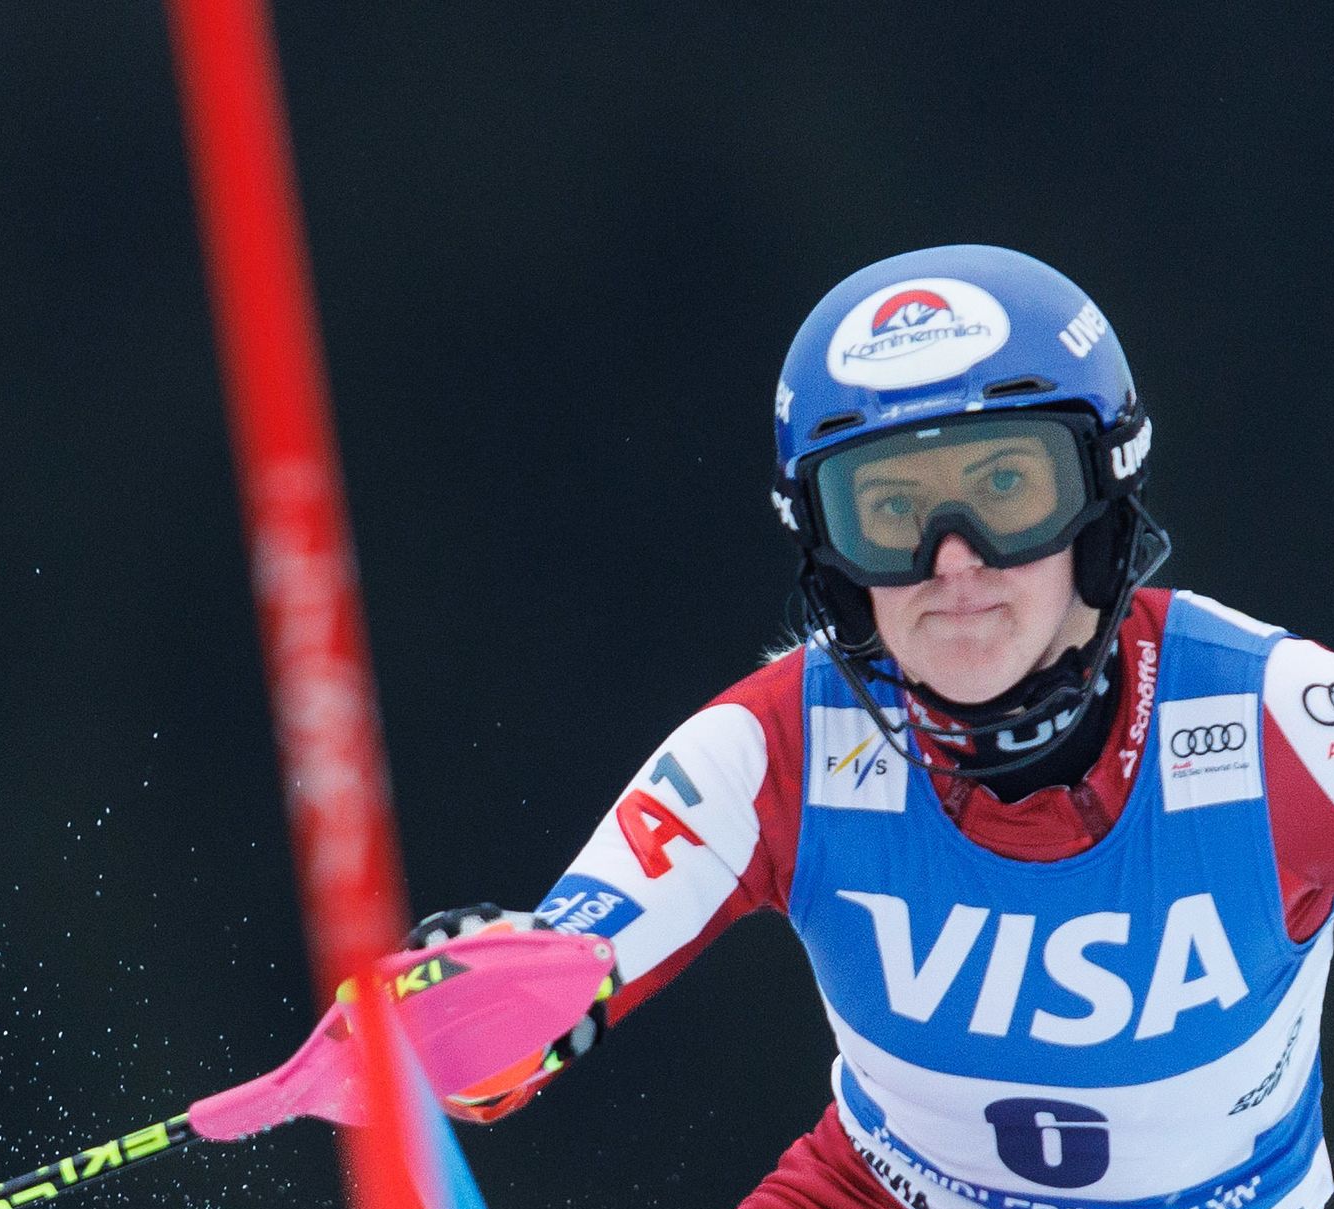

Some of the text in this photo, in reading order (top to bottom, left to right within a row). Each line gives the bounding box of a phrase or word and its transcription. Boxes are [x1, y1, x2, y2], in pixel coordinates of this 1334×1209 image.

[616, 751, 707, 880] A1
[553, 891, 625, 934] NIQA
[836, 889, 1251, 1047] VISA
[60, 1113, 185, 1185] EKI
[984, 1096, 1111, 1189] 6
